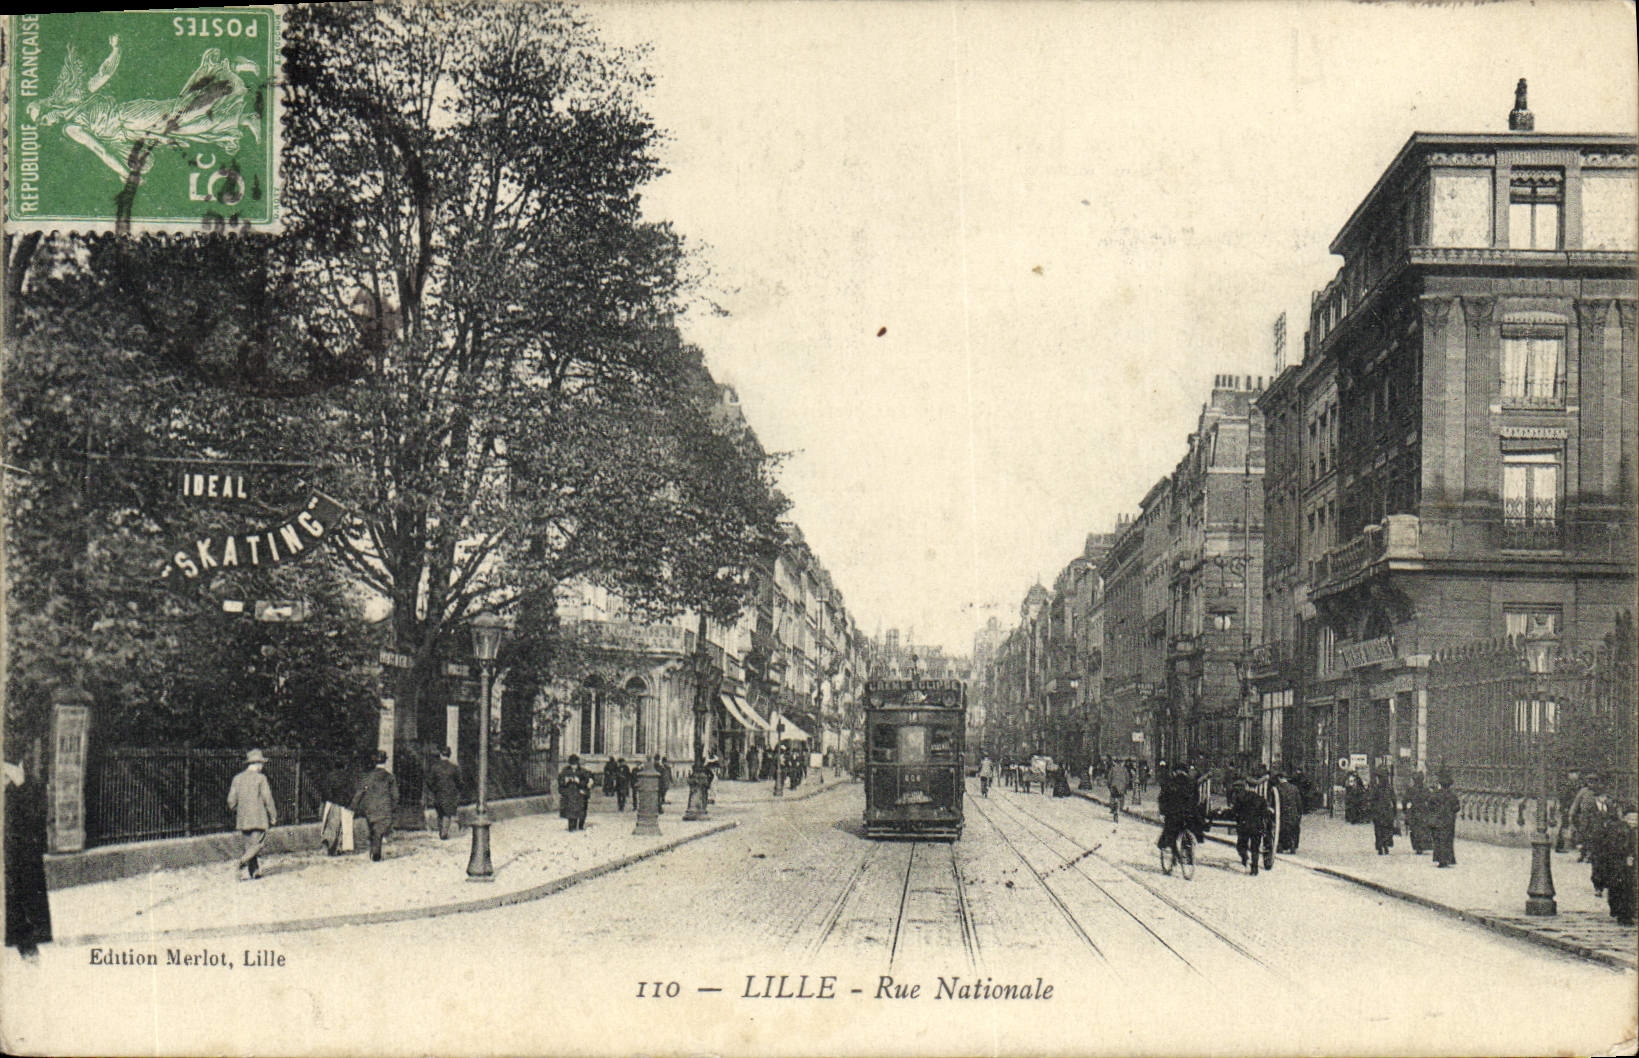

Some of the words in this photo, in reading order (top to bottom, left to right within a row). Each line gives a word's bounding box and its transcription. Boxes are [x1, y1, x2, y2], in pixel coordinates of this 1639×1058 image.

[20, 14, 42, 97] FRANÇAISE
[173, 17, 258, 38] POSTES
[20, 123, 39, 213] REPUBLIQUE
[184, 474, 247, 499] IDEAL
[174, 511, 323, 578] SKATING
